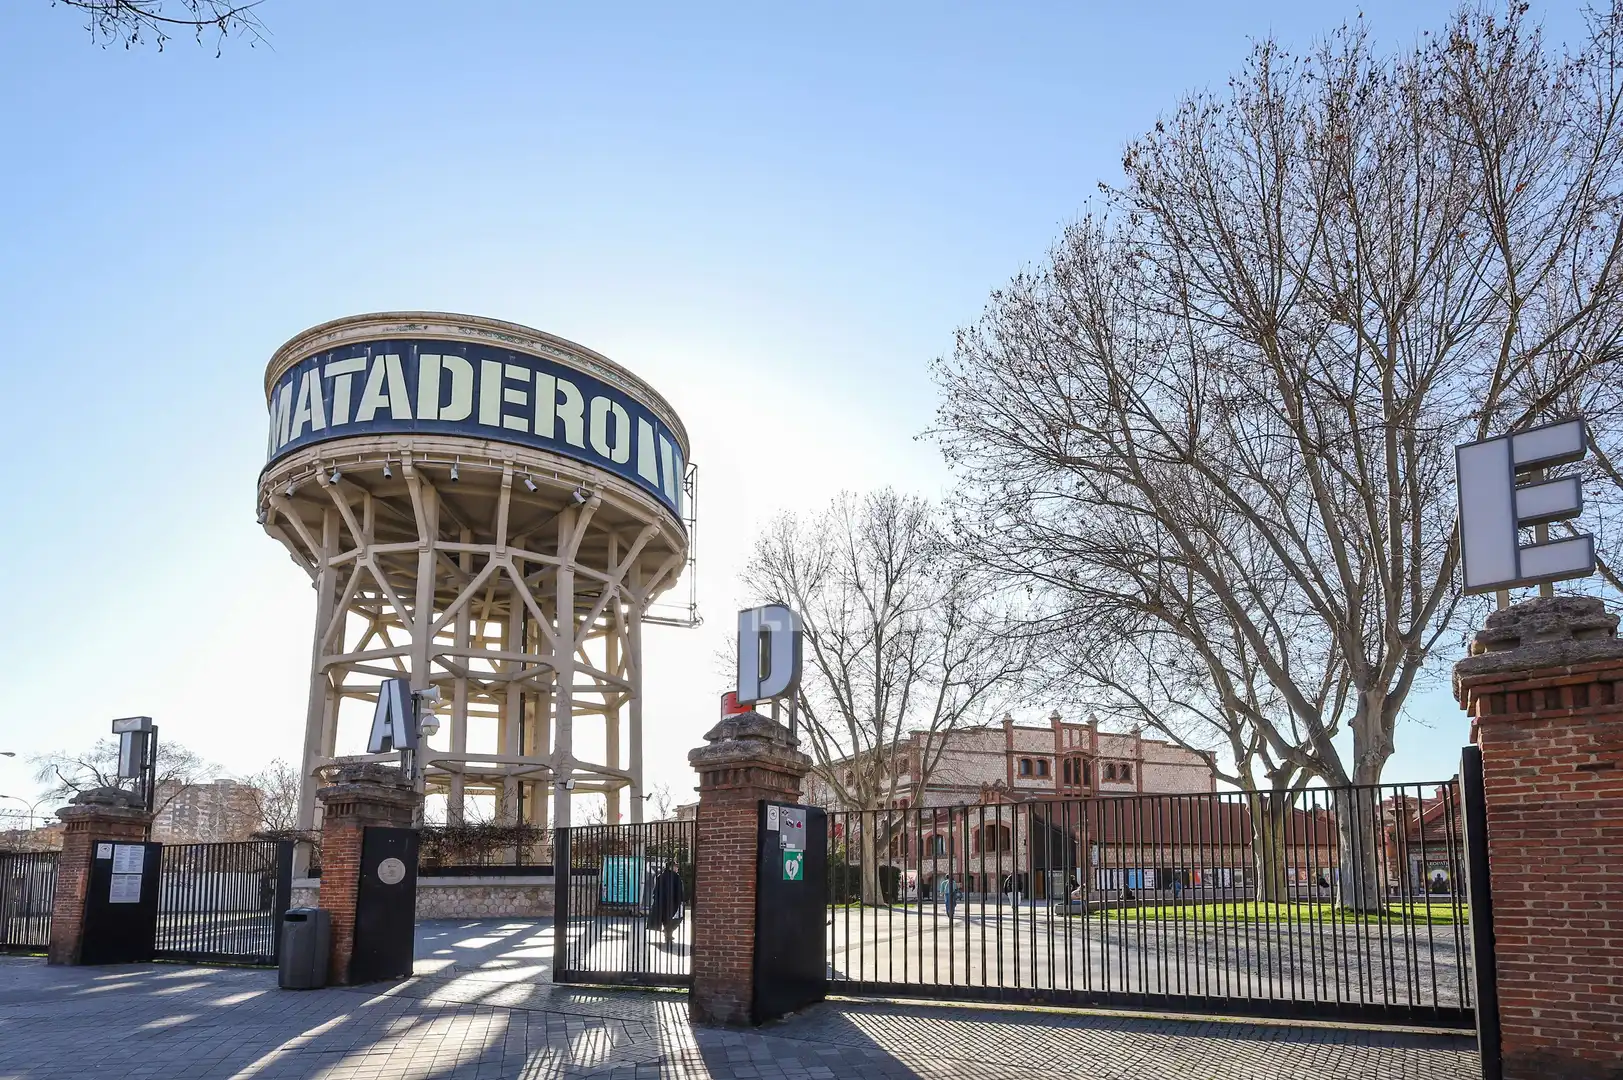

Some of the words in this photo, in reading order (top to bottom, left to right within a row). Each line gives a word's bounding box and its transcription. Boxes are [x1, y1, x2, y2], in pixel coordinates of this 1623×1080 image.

[269, 353, 631, 465] MATADERO
[1455, 416, 1596, 595] E
[737, 603, 802, 704] D
[366, 678, 418, 754] A
